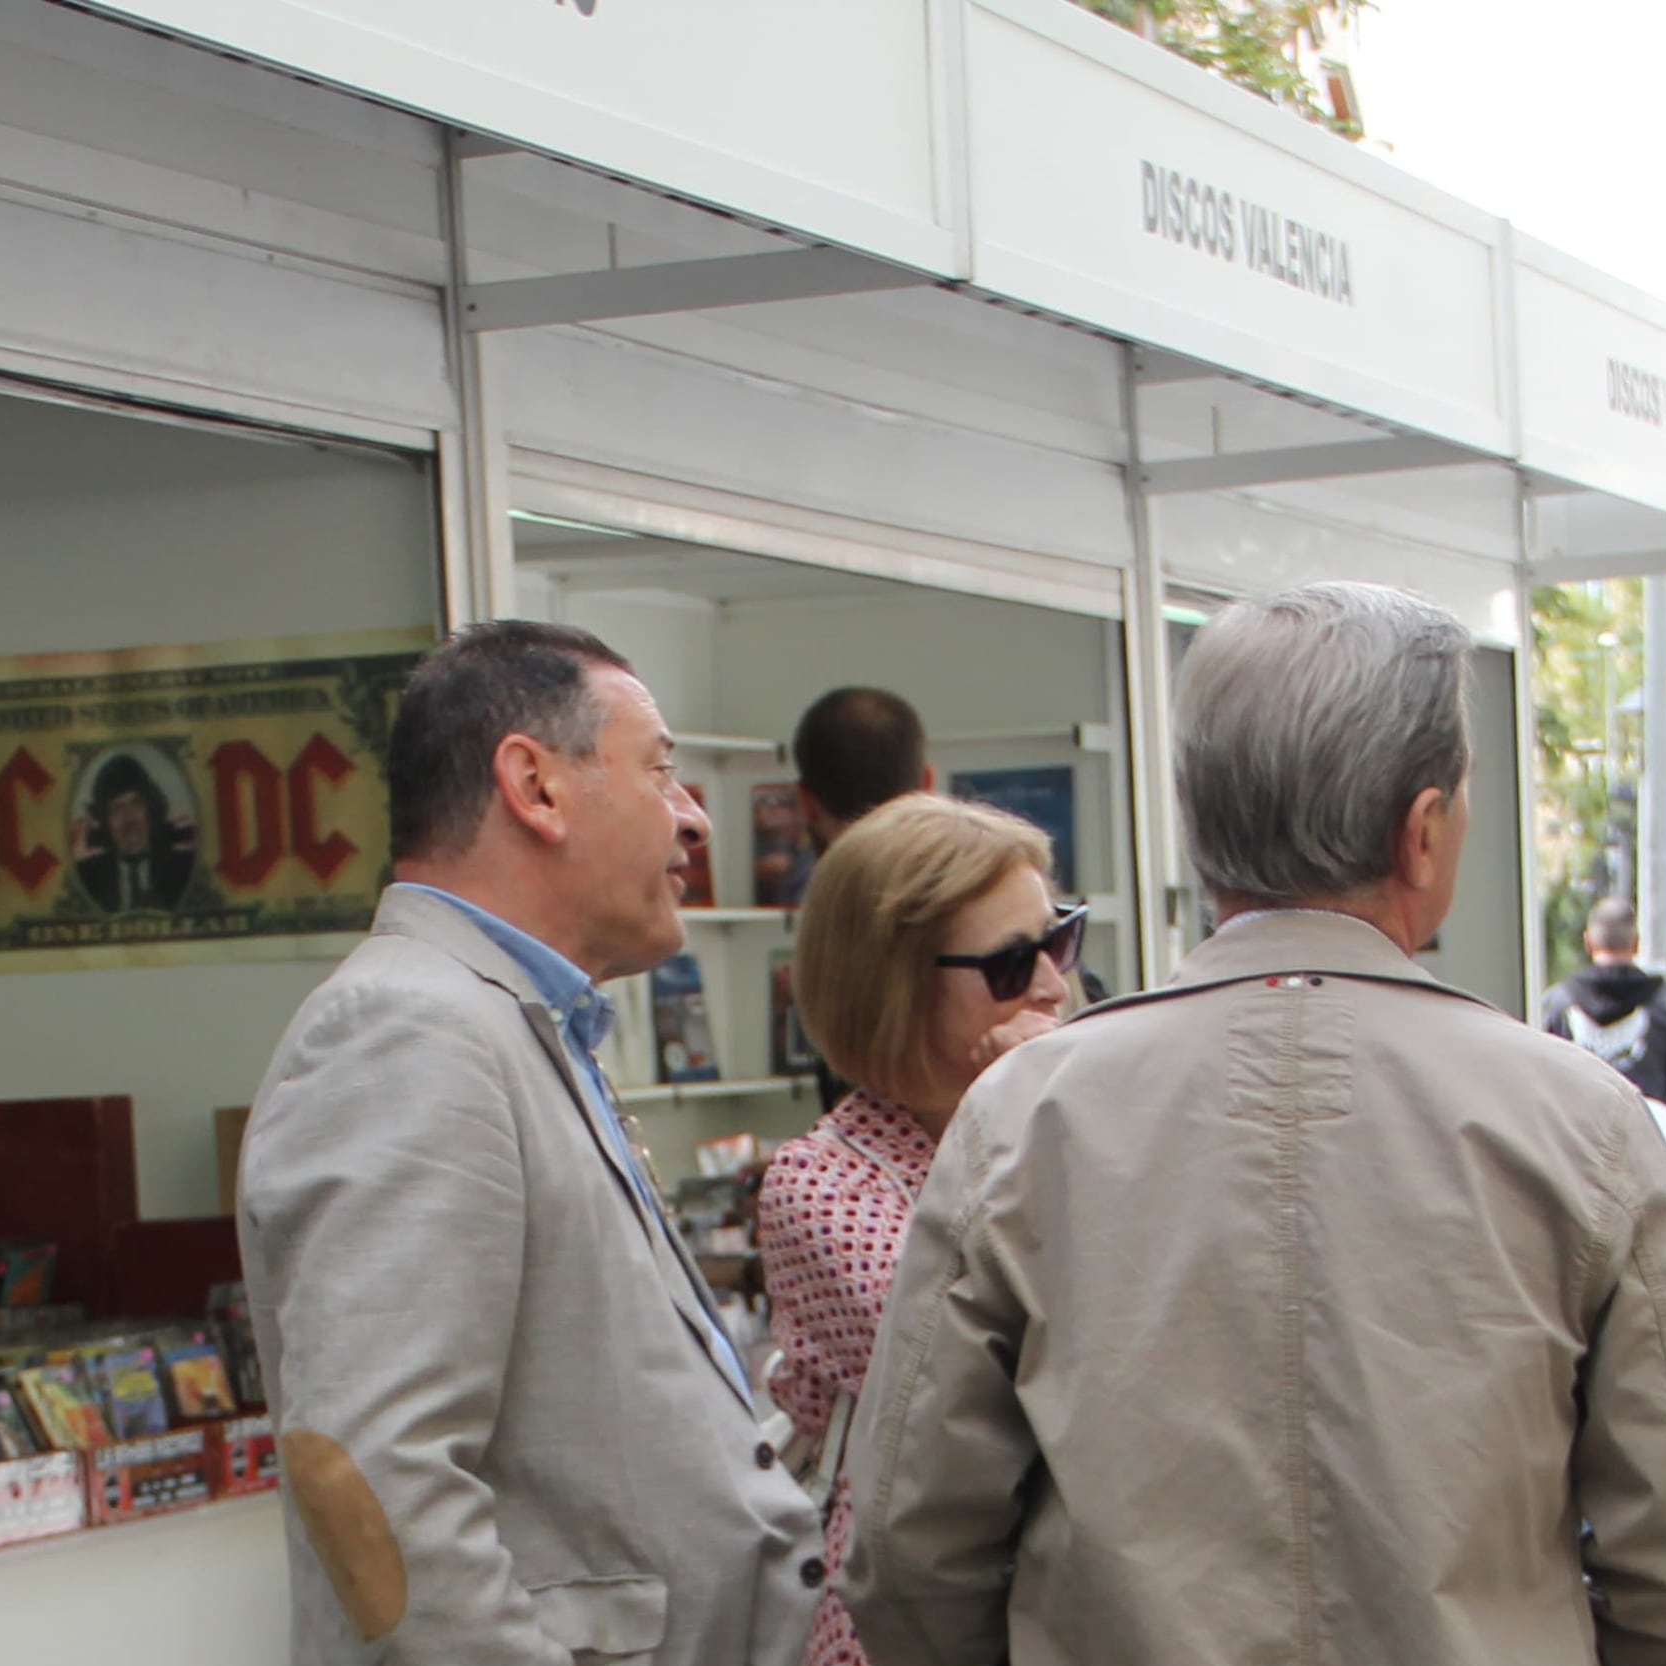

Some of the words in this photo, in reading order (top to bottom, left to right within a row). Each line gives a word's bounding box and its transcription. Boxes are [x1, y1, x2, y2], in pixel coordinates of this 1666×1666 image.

[1140, 159, 1234, 263] DISCOS
[1238, 197, 1357, 309] VALENCIA
[1606, 357, 1662, 426] DISCOS
[78, 698, 173, 725] STATES
[209, 731, 359, 894] DC
